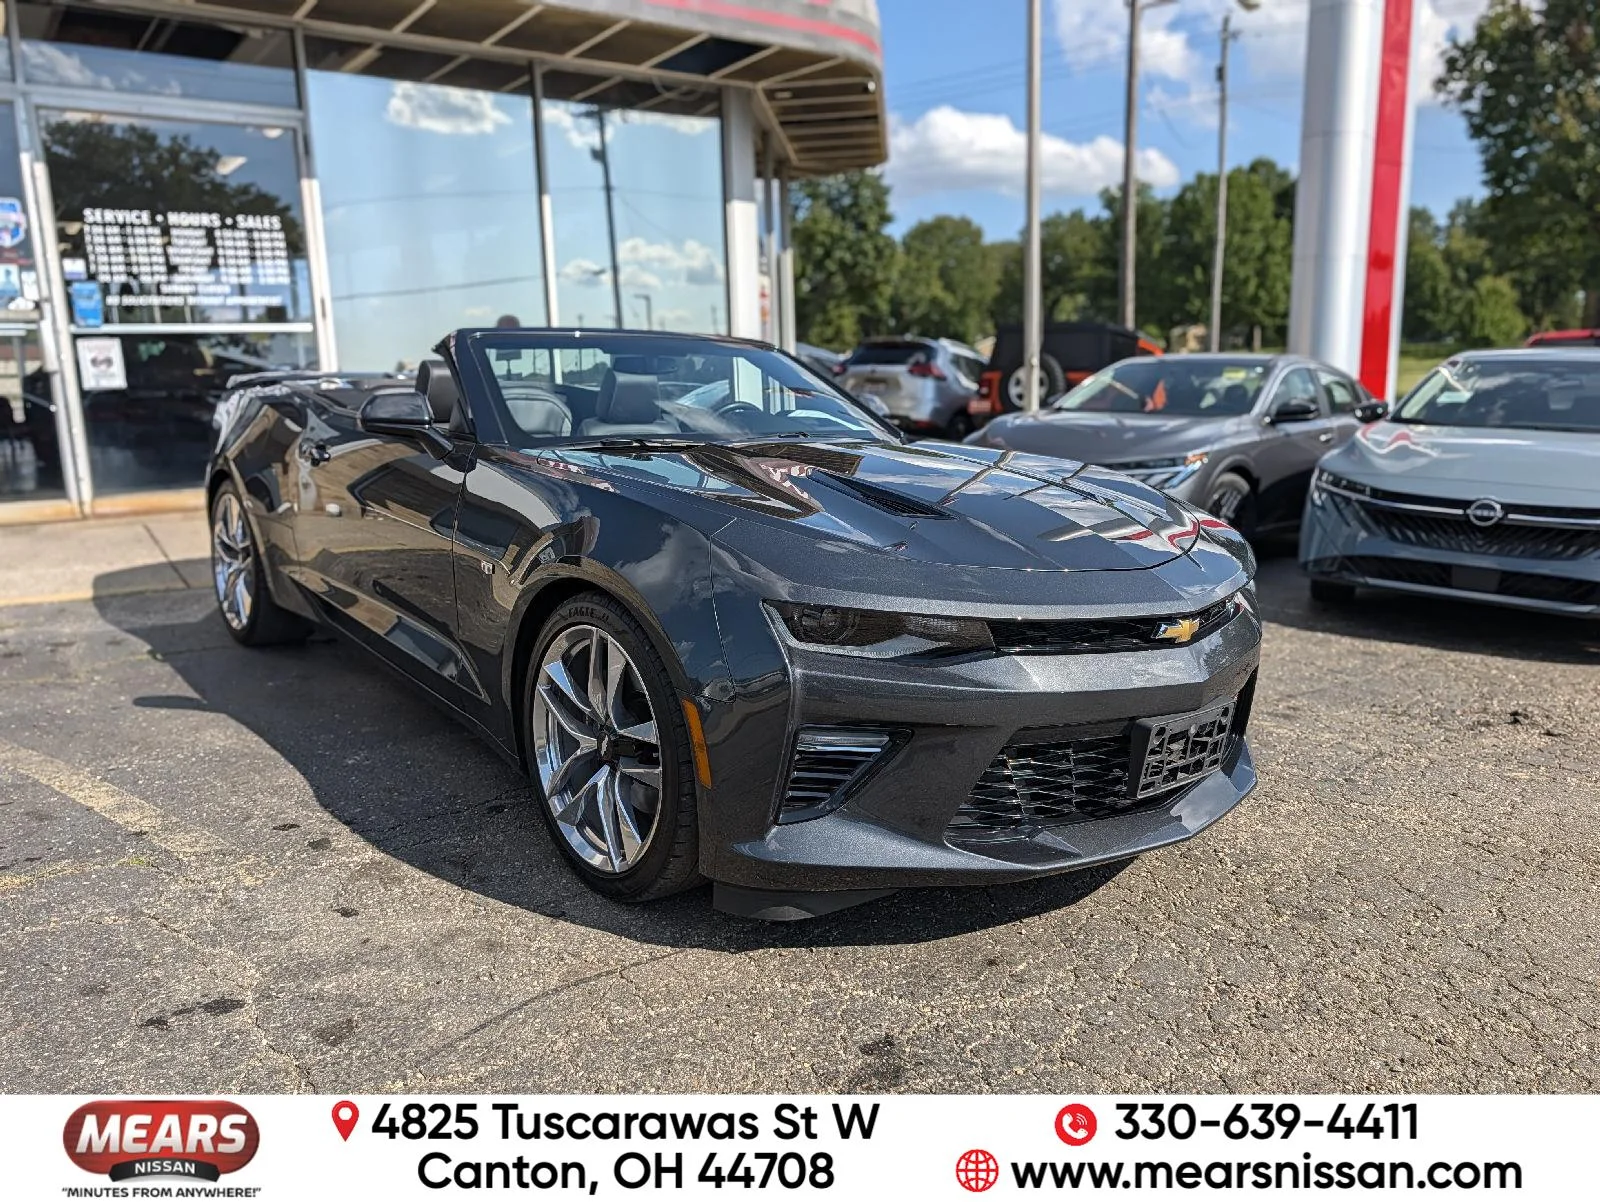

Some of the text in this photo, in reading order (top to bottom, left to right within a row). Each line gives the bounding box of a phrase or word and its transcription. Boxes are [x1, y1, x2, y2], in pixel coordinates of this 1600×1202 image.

[83, 208, 282, 230] SERVICE HOURS SALES
